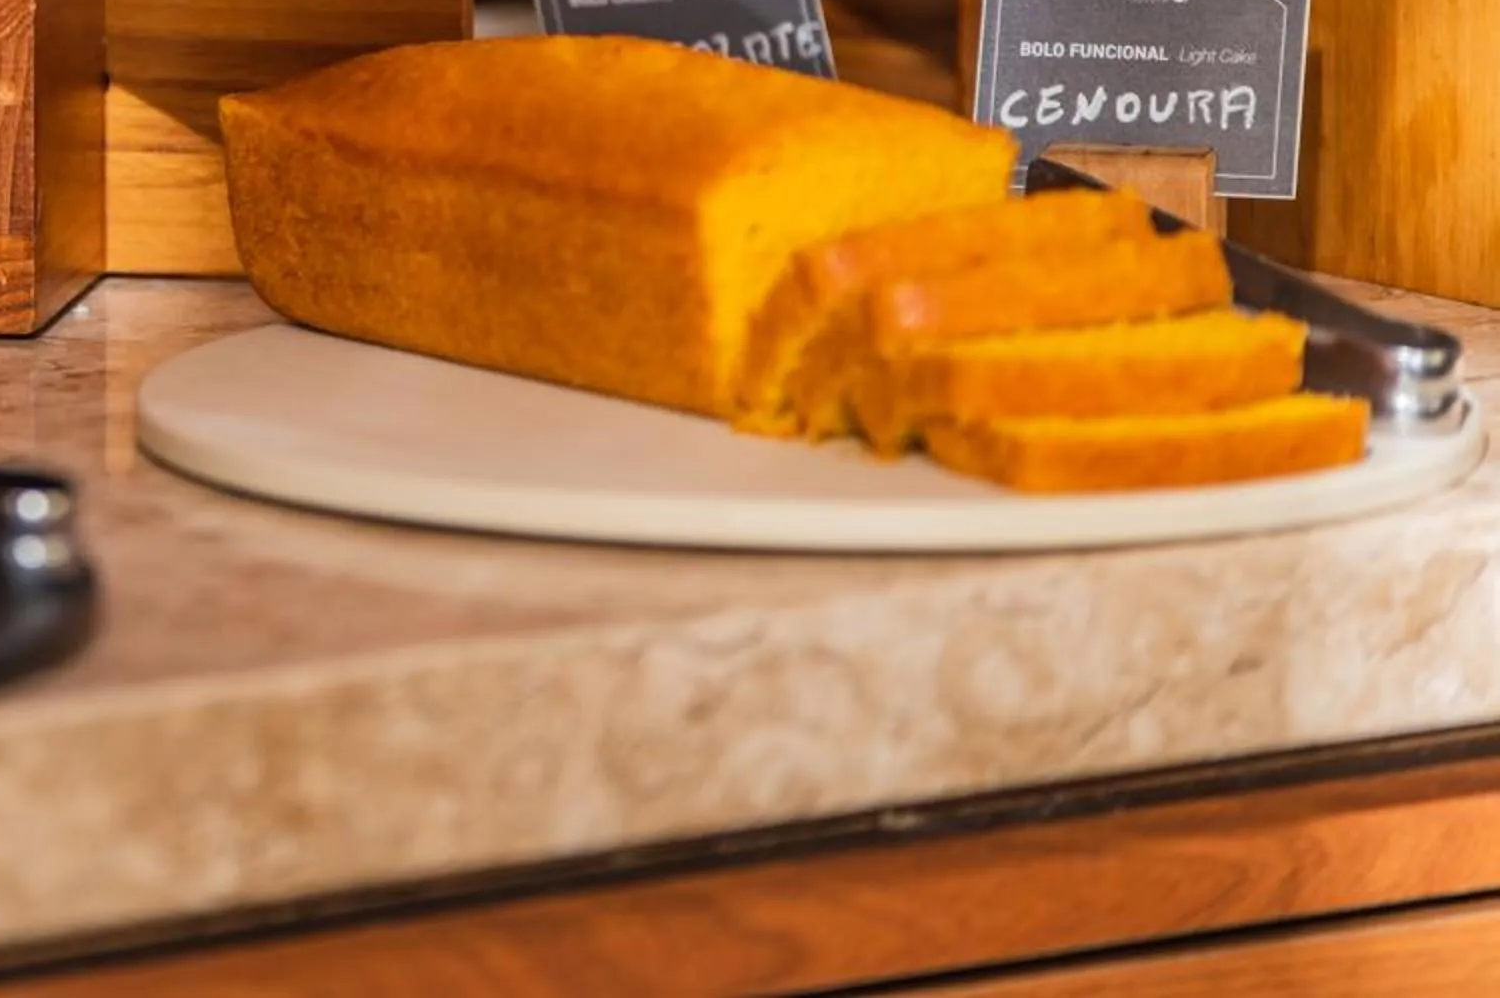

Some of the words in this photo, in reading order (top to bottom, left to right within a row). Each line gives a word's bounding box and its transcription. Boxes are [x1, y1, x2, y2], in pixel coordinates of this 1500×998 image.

[1019, 40, 1065, 58] BOLO
[1069, 42, 1169, 62] FUNCIONAL
[1179, 45, 1217, 67] Light
[1219, 47, 1257, 65] Cake
[1000, 83, 1257, 130] CENOURA
